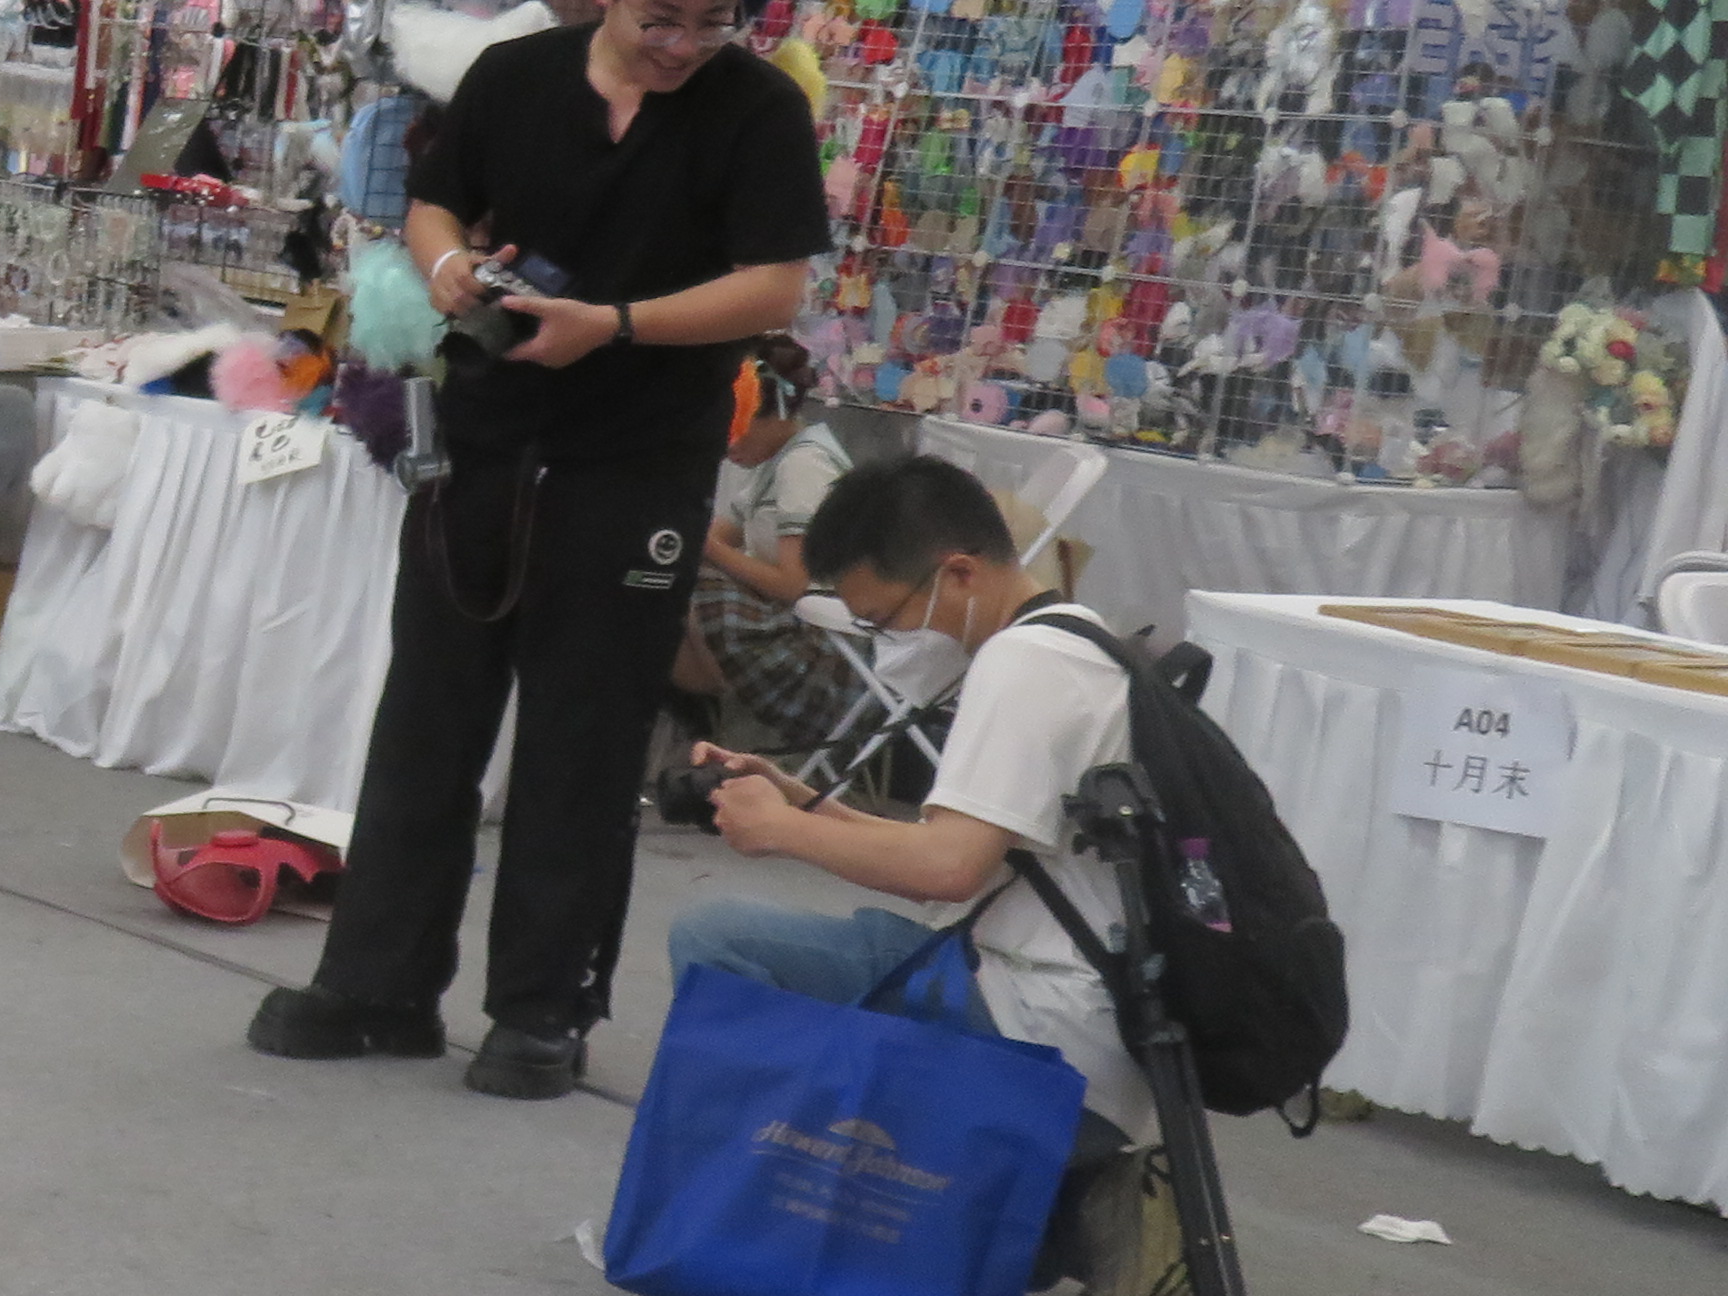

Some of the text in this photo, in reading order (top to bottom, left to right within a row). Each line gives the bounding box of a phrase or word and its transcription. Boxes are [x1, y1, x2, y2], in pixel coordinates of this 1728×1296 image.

[1454, 708, 1511, 738] A04
[1423, 750, 1531, 800] 十月末
